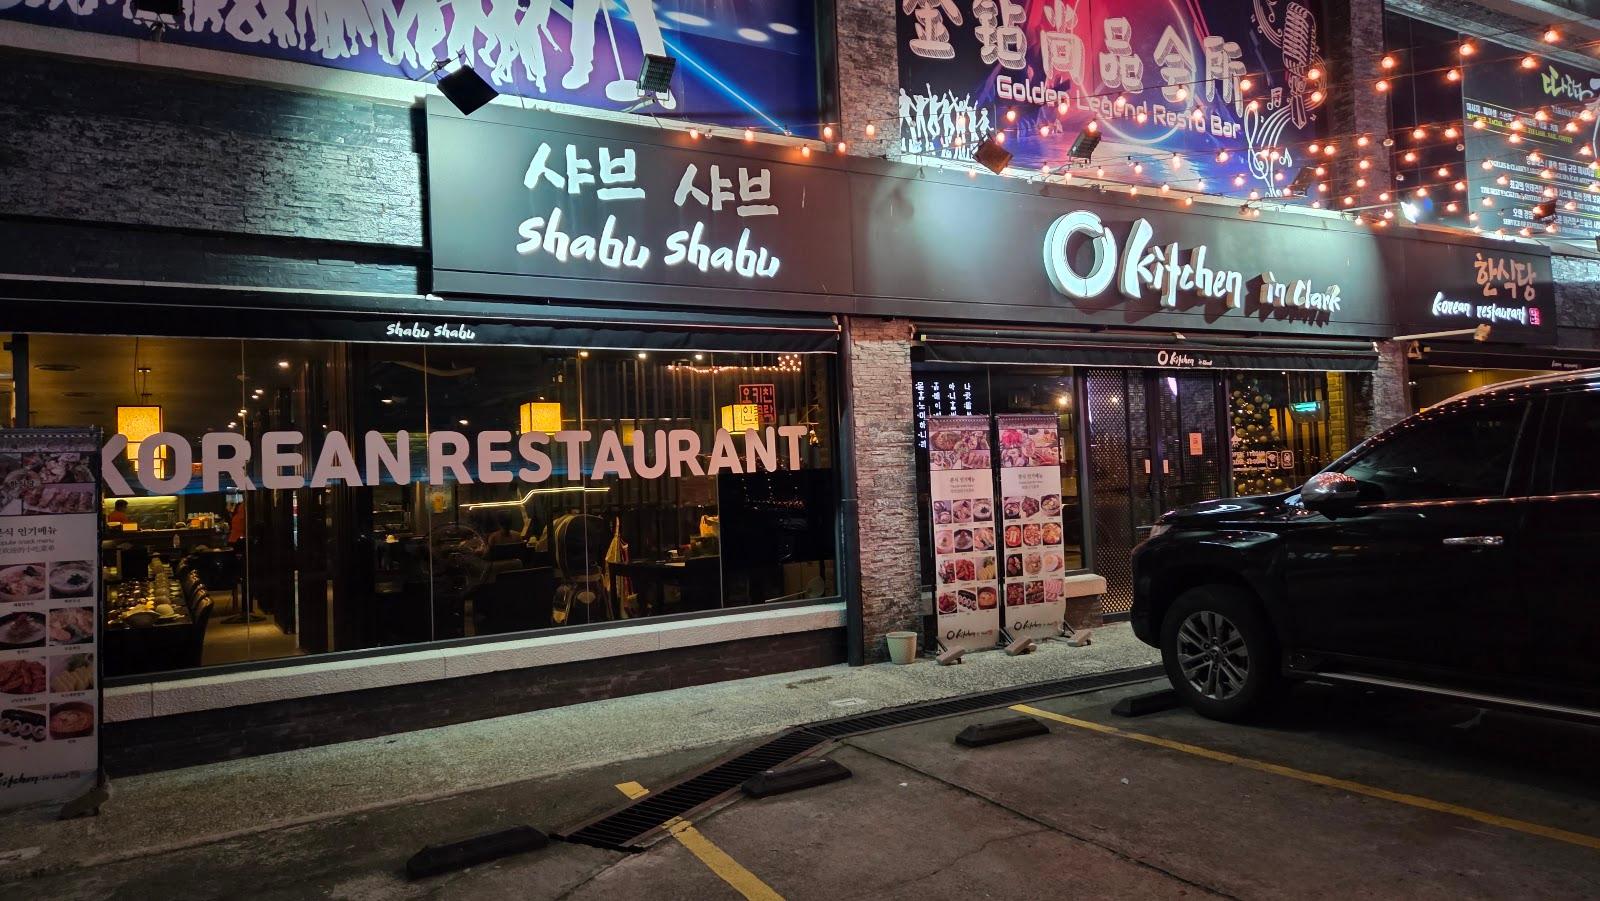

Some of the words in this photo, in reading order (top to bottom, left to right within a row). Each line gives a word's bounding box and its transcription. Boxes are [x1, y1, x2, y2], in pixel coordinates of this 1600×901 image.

[996, 74, 1070, 105] Golden
[1076, 90, 1148, 120] Legend
[1153, 104, 1205, 132] Resto
[1210, 115, 1241, 139] Bar
[523, 142, 645, 201] 샤브
[674, 163, 779, 217] 샤브
[1043, 210, 1118, 298] O
[1260, 271, 1285, 308] in
[1286, 278, 1341, 312] Clark
[1474, 253, 1536, 301] 한식당
[1476, 303, 1526, 325] restaurant
[101, 430, 411, 495] KOREAN
[429, 425, 807, 485] RESTAURANT
[18, 526, 57, 537] 인기메뉴
